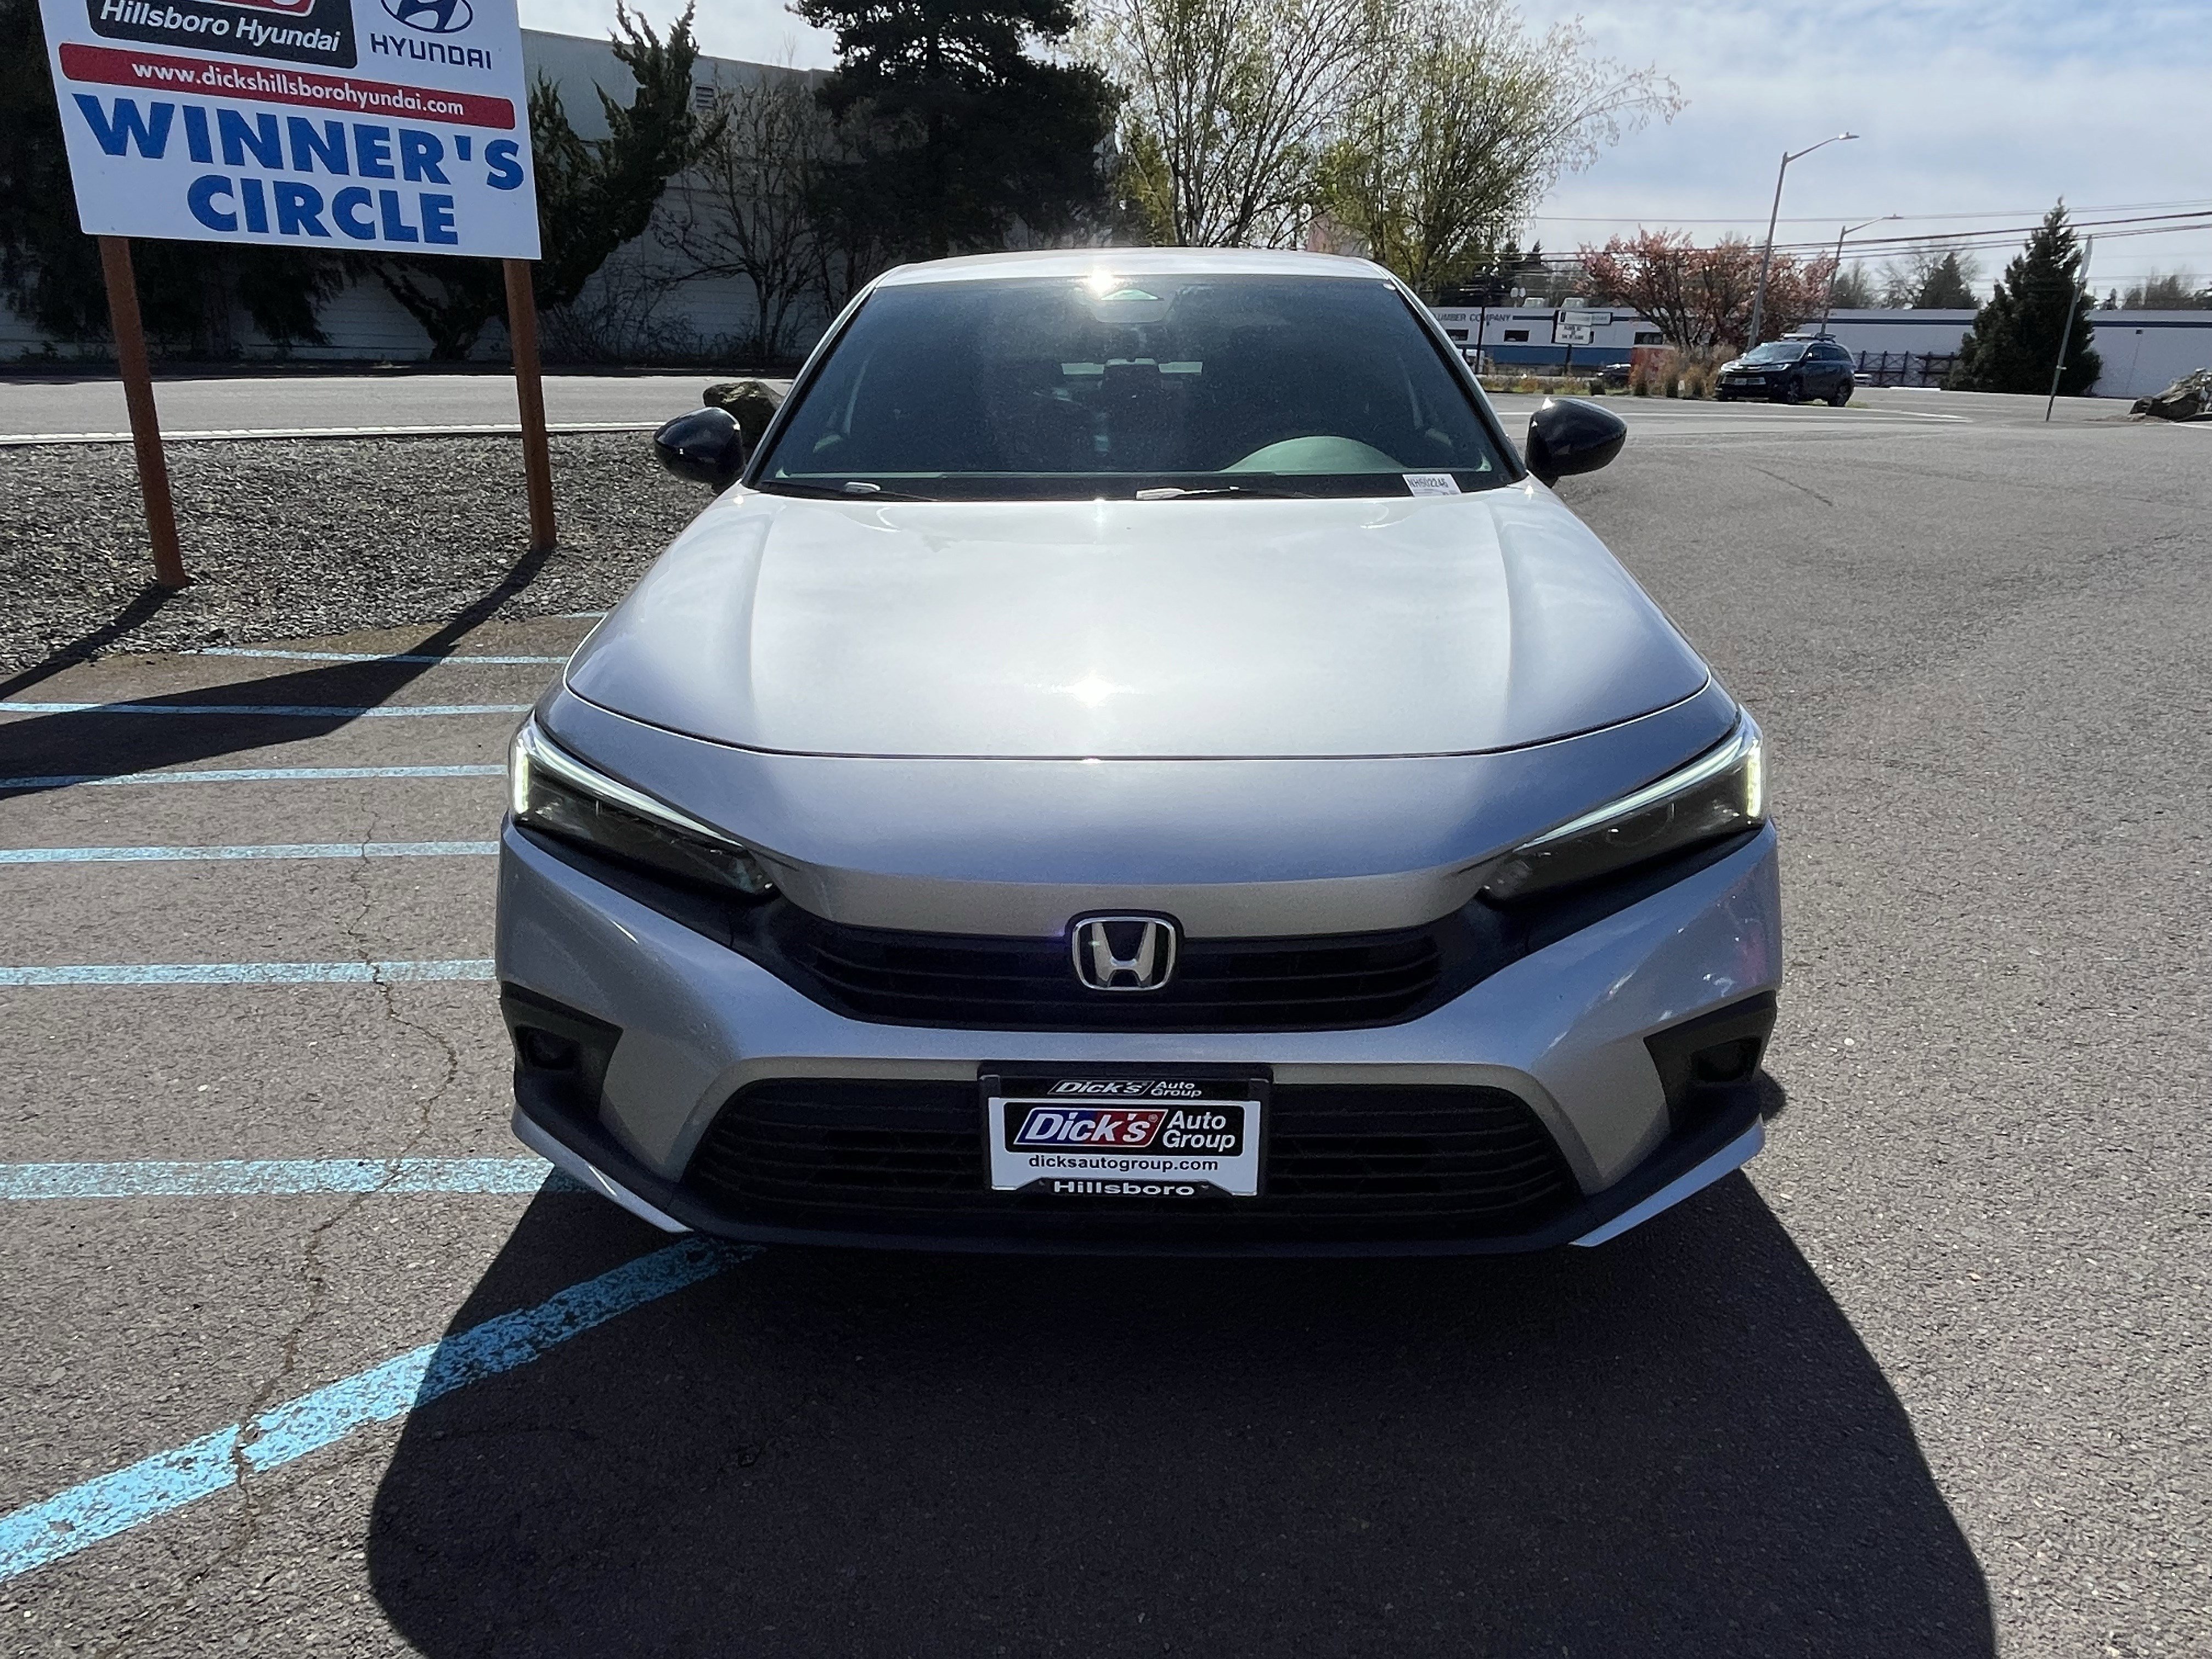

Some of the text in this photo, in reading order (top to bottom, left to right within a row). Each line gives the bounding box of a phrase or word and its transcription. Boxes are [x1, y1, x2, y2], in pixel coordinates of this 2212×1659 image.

[100, 0, 341, 52] Hillsboro Hyundai
[370, 33, 492, 70] HYUNDAI
[132, 59, 464, 116] www.dickshillsborohyundai.com
[71, 93, 525, 191] WINNER'S
[187, 174, 459, 245] CIRCLE
[1437, 313, 1466, 321] UMBER
[1056, 1080, 1143, 1093] Dick's
[1150, 1089, 1202, 1098] Group
[1154, 1081, 1195, 1090] Auto
[1025, 1111, 1150, 1143] Dick's
[1167, 1110, 1227, 1130] Auto
[1163, 1129, 1235, 1152] Group
[1028, 1155, 1218, 1172] dicksautogroup.com
[1054, 1181, 1195, 1196] Hillsboro
